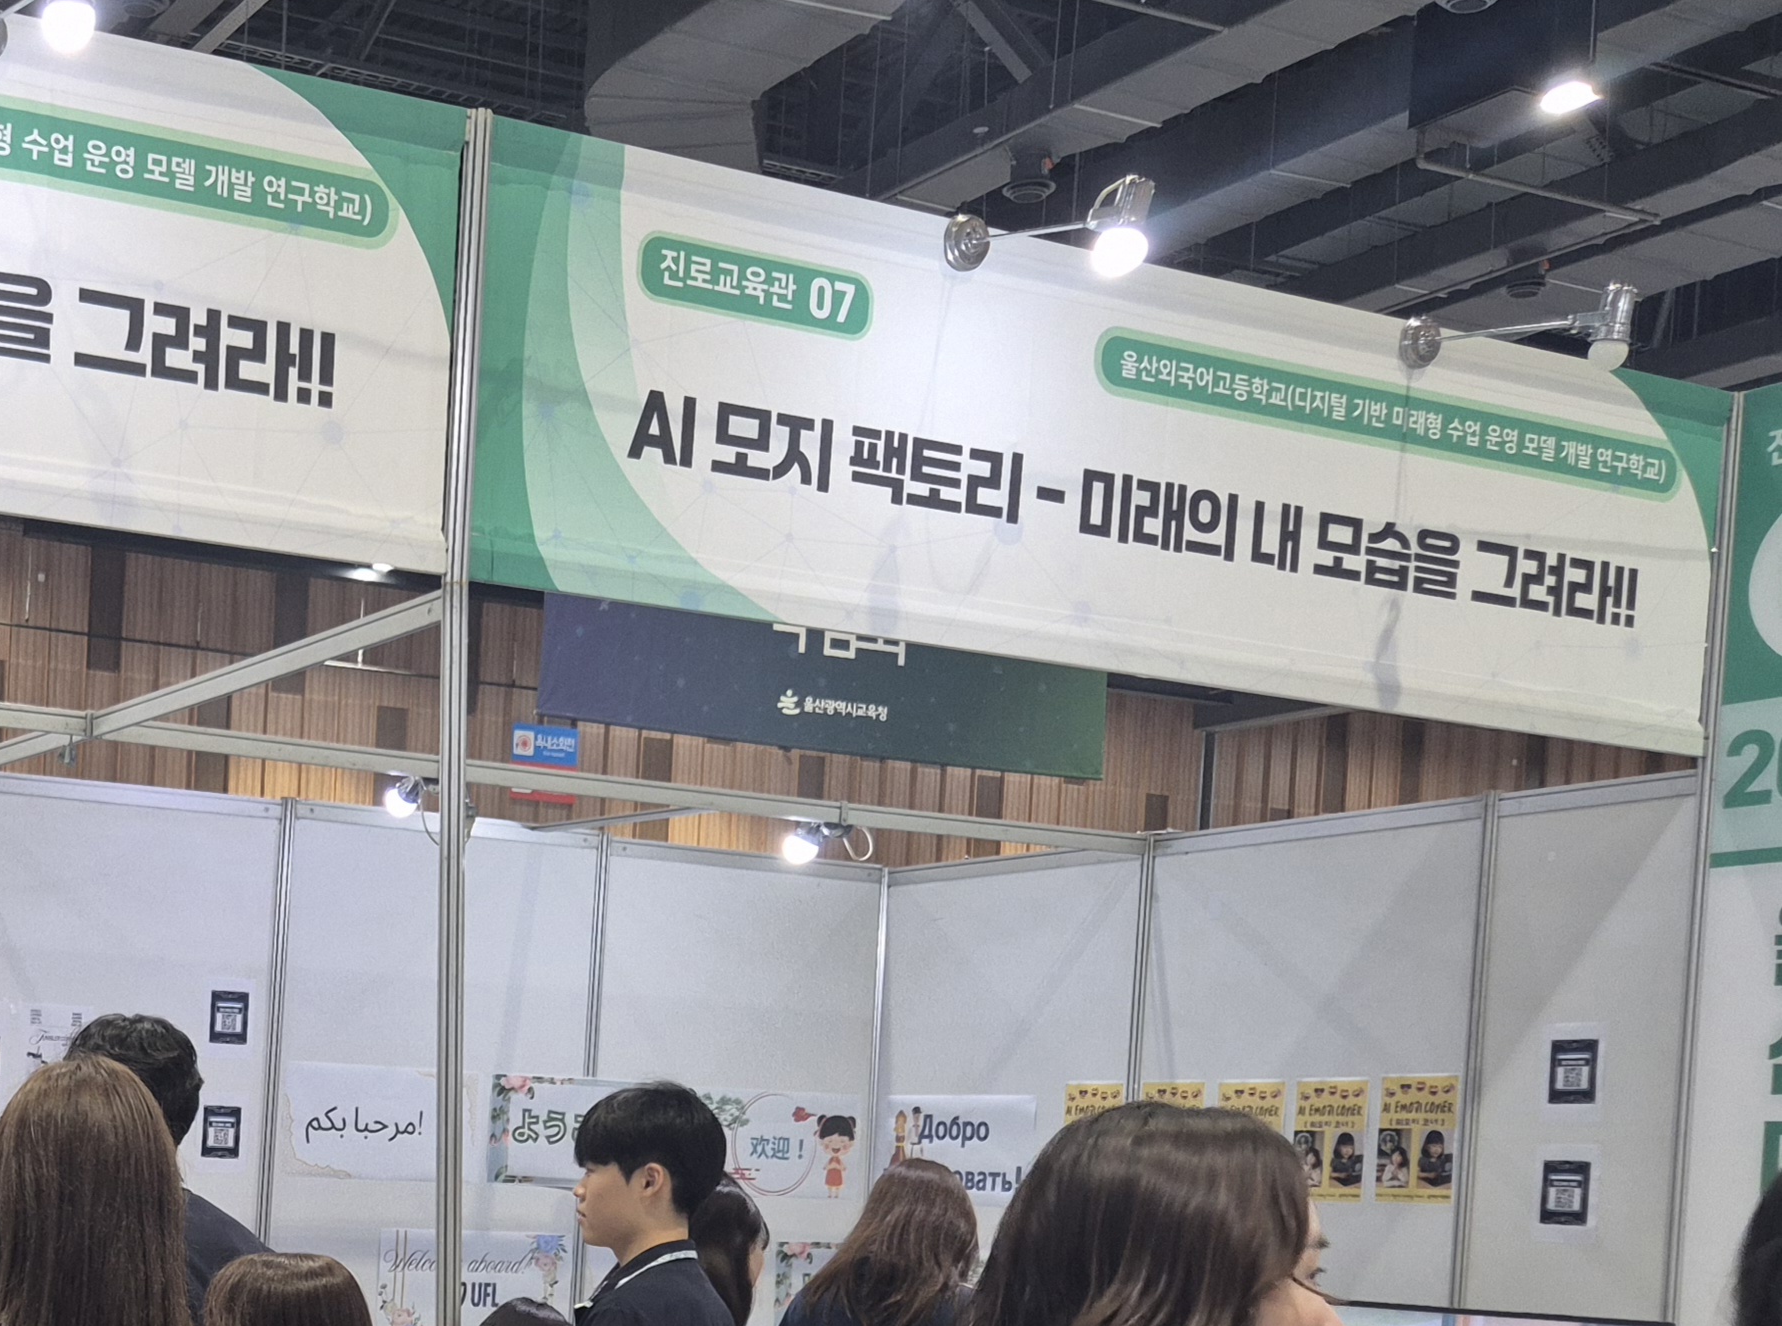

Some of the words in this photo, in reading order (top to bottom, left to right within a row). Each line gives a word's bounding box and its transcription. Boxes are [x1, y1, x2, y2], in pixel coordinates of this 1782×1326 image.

[22, 127, 73, 169] 수업
[83, 136, 136, 178] 운영
[143, 147, 196, 192] 모델
[205, 161, 256, 203] 개발
[264, 172, 374, 227] 연구학교)
[659, 248, 797, 310] 진로교육관
[808, 277, 855, 323] 07
[75, 288, 335, 407] 그려라!!
[1119, 350, 1348, 422] 울산외국어고등학교(디지털
[1353, 394, 1387, 427] 기반
[1392, 402, 1442, 441] 미래형
[1447, 417, 1480, 447] 수업
[1485, 423, 1518, 455] 운영
[1522, 431, 1555, 462] 모델
[1559, 438, 1592, 470] 개발
[1597, 446, 1667, 485] 연구학교)
[628, 390, 696, 467] AI
[712, 402, 833, 492] 모지
[850, 426, 1023, 523] 팩토리
[1080, 469, 1238, 561] 미래의
[1252, 501, 1302, 572] 내
[1314, 512, 1459, 599] 모습을
[1472, 540, 1638, 627] 그려라!!
[803, 696, 888, 722] 울산광역시교육청
[305, 1104, 348, 1144] بكم
[920, 1114, 990, 1148] Добро
[471, 1282, 500, 1307] UFL
